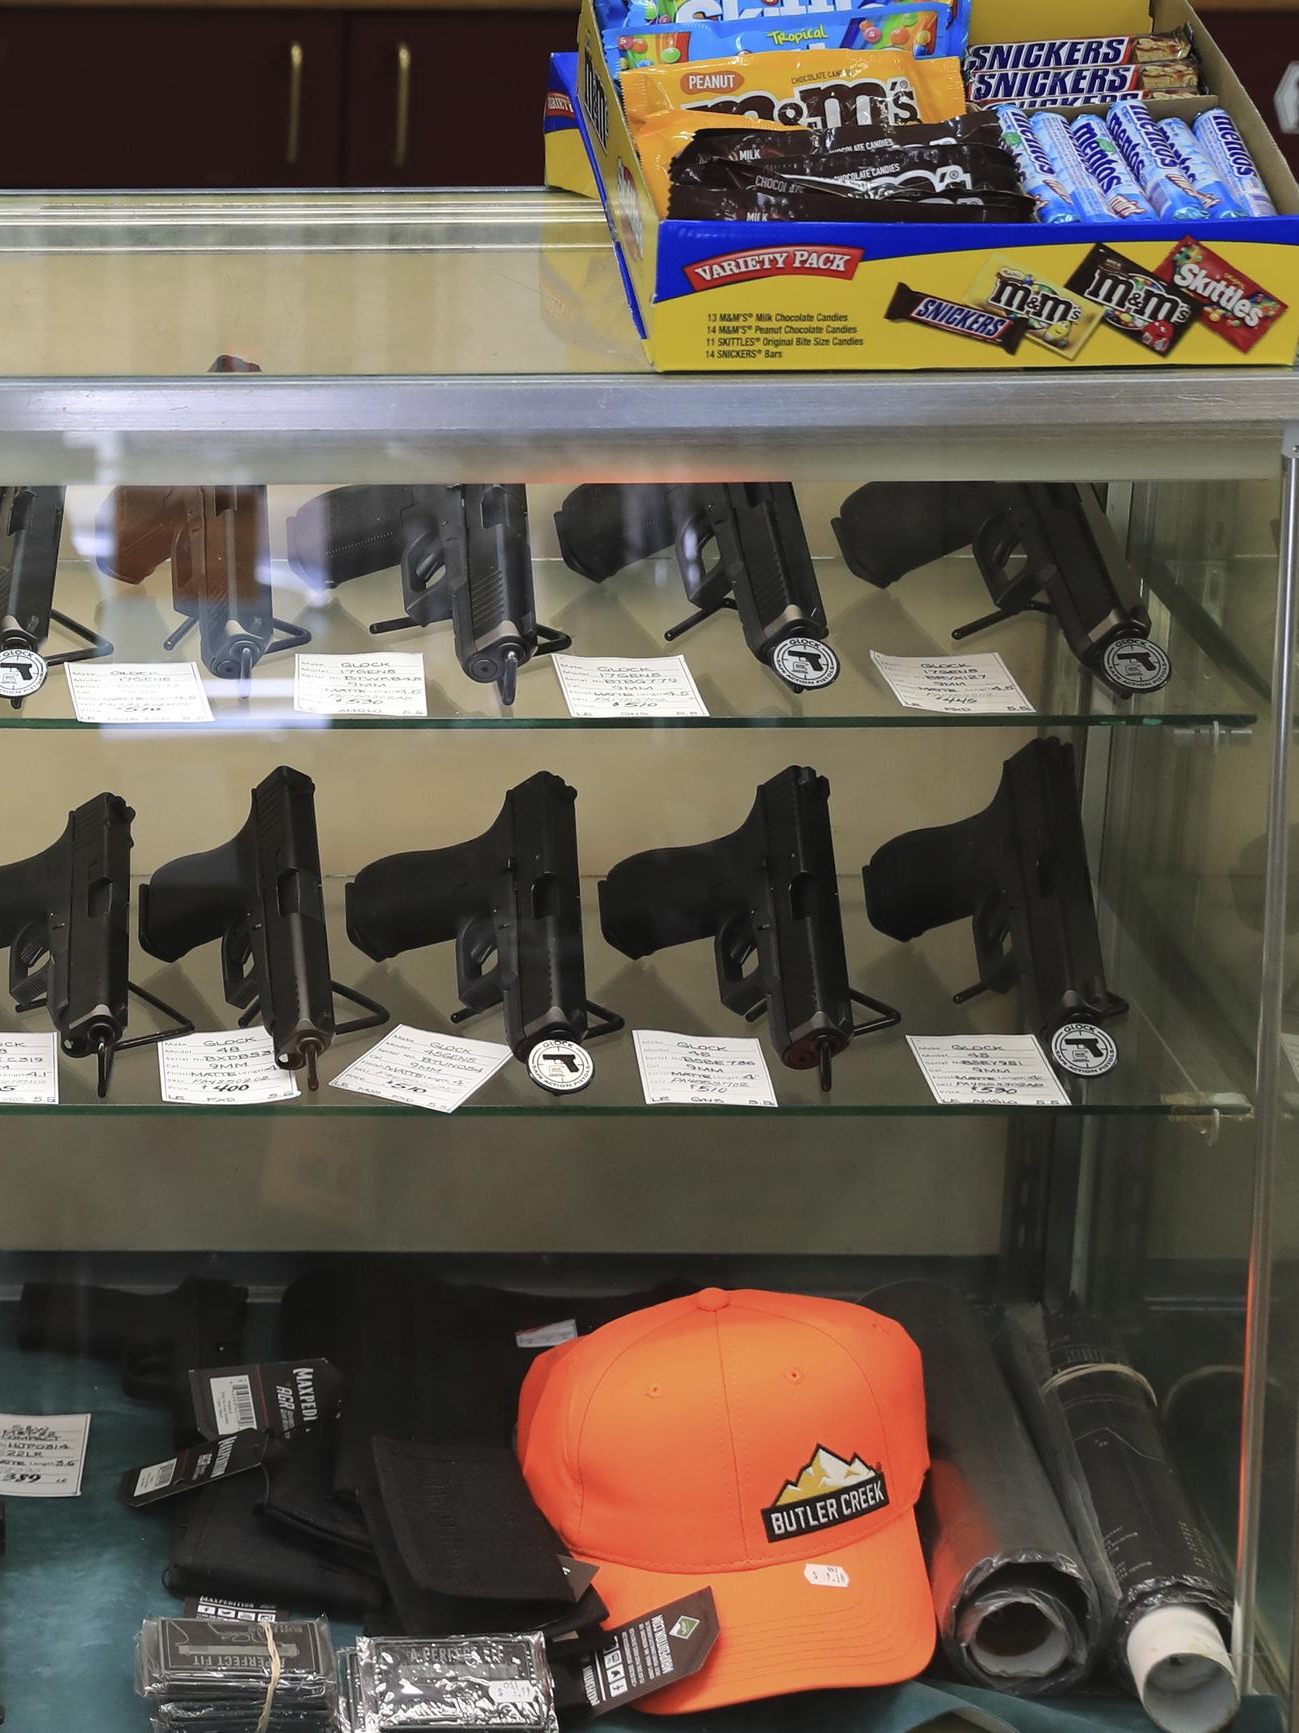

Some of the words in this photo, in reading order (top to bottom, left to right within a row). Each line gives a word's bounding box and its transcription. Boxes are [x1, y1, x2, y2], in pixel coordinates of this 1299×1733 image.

[767, 24, 828, 46] Tropical
[968, 38, 1125, 70] SNICKERS
[688, 74, 736, 90] PEANUT
[791, 70, 827, 85] CHOCOLATE
[973, 66, 1132, 100] SNICKERS
[739, 149, 761, 161] MILK
[1071, 121, 1123, 195] mentos
[872, 162, 901, 176] CANDIES
[695, 252, 790, 282] VARIETY
[792, 250, 852, 273] PACK
[1173, 262, 1263, 328] Skittles
[707, 313, 717, 322] 13
[755, 313, 772, 322] Milk
[775, 313, 814, 322] Chocolate
[816, 313, 848, 322] Candies
[917, 297, 1005, 338] SNICKERS
[706, 325, 716, 334] 14
[755, 325, 782, 334] Peanut
[784, 325, 823, 334] Chocolate
[825, 325, 857, 334] Candies
[706, 337, 715, 346] 11
[762, 337, 793, 348] Original
[795, 337, 811, 346] Bite
[813, 337, 830, 346] Size
[832, 337, 864, 346] Candies
[705, 350, 715, 359] 14
[764, 350, 782, 359] Bars
[789, 637, 820, 648] GLOCK
[1115, 638, 1147, 648] GLOCK
[2, 649, 34, 658] GLOCK
[1063, 1023, 1096, 1033] GLOCK
[204, 1036, 258, 1047] GLOCK
[542, 1040, 574, 1048] GLOCK
[677, 1041, 729, 1051] GLOCK
[430, 1041, 473, 1054] GLOCK
[383, 1065, 424, 1079] MATTE
[409, 1062, 443, 1073] 9MM
[686, 1064, 723, 1073] 9MM
[1068, 1063, 1098, 1074] ACTION
[670, 1071, 712, 1079] MATTE
[543, 1078, 573, 1088] ACTION
[276, 1385, 295, 1410] AGR
[293, 1368, 318, 1422] MAXPEDI
[771, 1498, 839, 1535] BUTLER
[840, 1480, 885, 1516] CREEK
[192, 1656, 212, 1666] FIT
